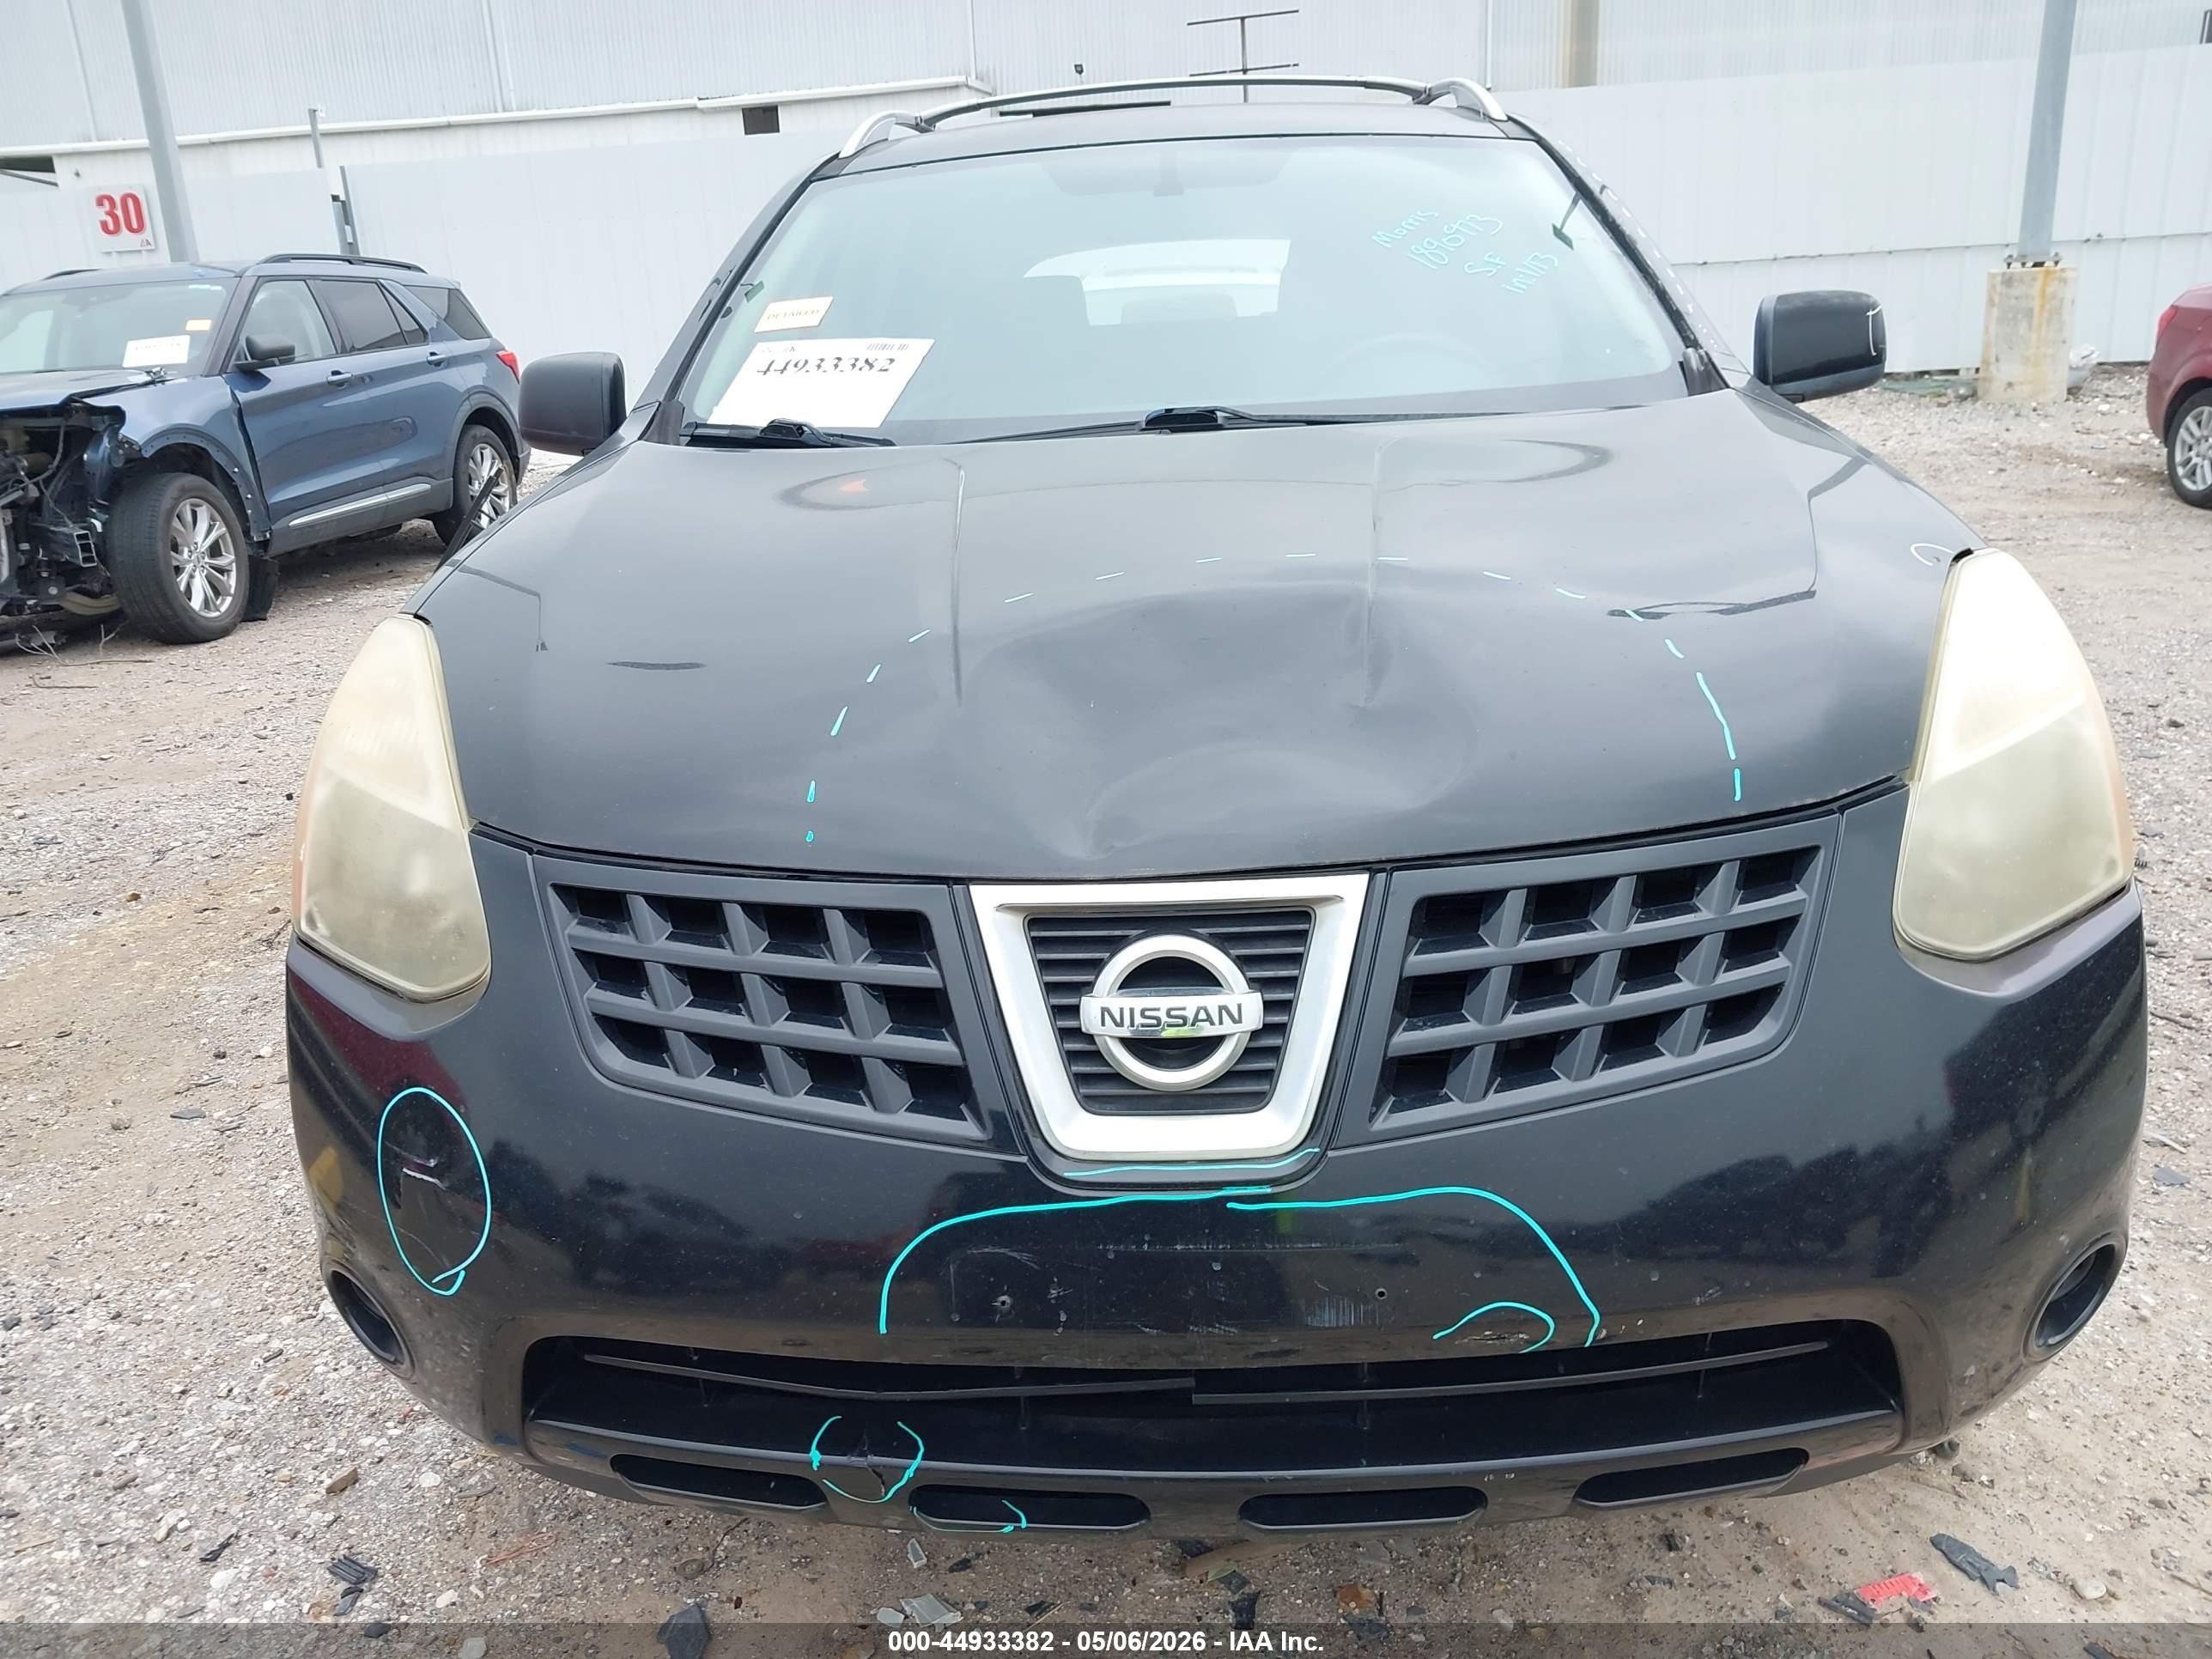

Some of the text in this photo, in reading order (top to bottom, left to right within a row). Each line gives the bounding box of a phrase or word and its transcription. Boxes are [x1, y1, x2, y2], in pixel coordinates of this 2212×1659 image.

[95, 192, 144, 235] 30
[757, 356, 896, 375] 44933382
[1100, 1003, 1243, 1028] NISSAN
